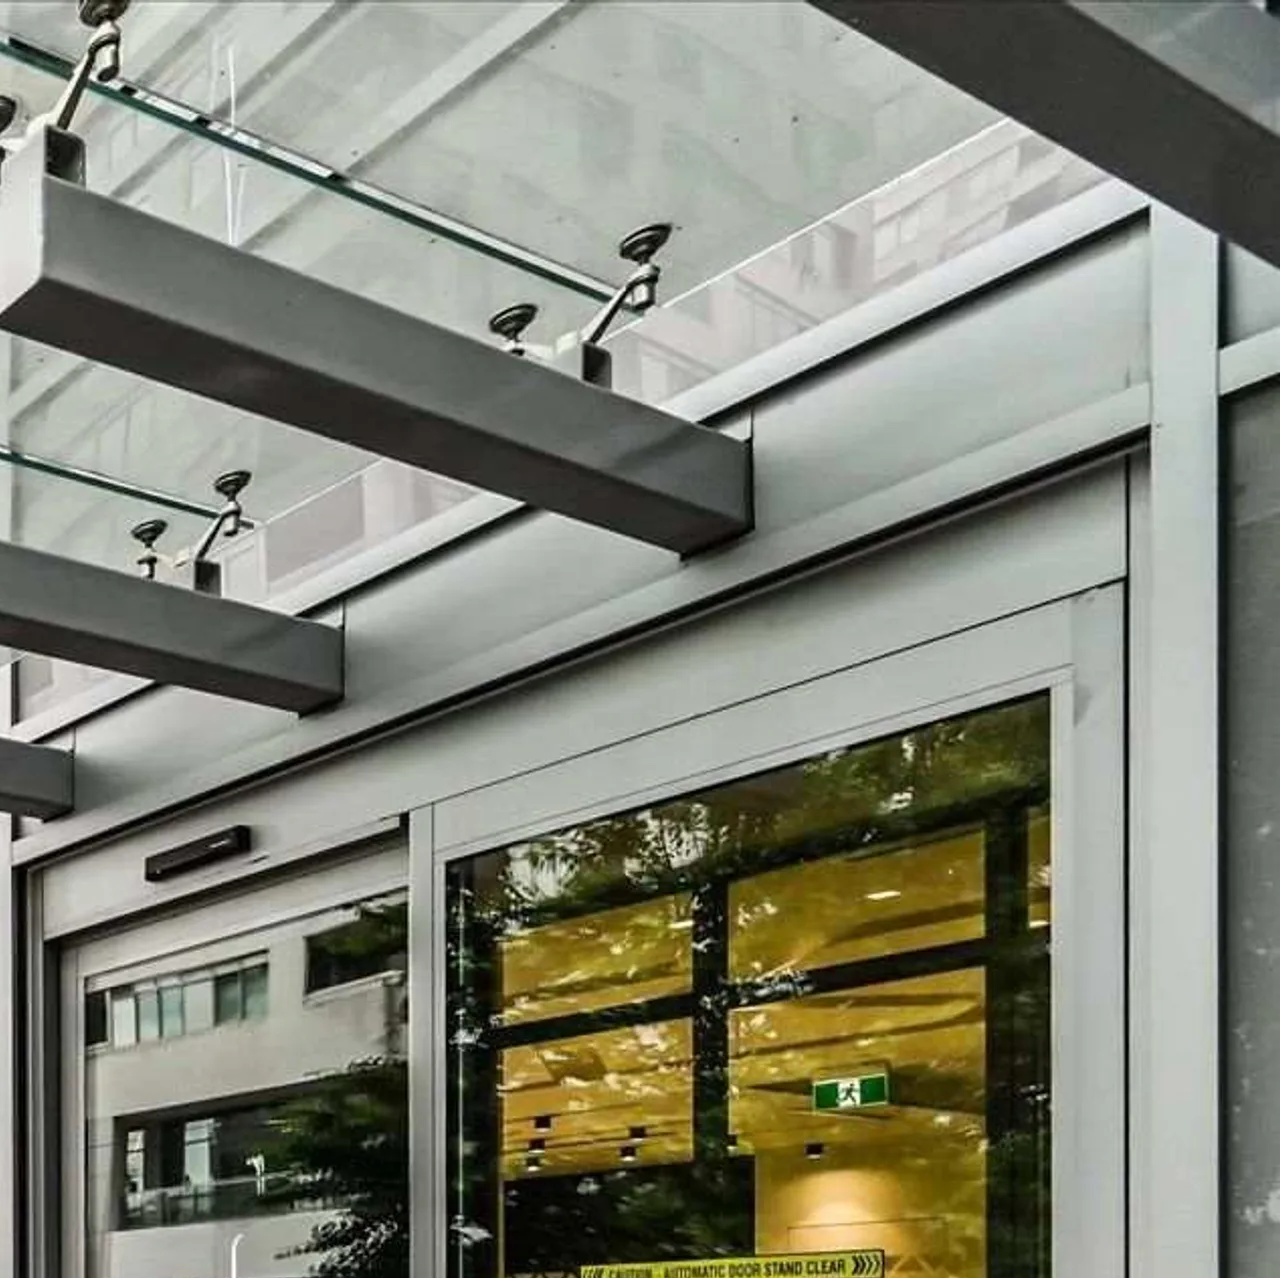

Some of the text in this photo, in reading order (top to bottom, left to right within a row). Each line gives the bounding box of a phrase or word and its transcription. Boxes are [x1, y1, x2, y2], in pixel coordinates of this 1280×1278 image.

[728, 1262, 761, 1278] DOOR
[763, 1260, 802, 1276] STAND
[806, 1258, 846, 1275] CLEAR
